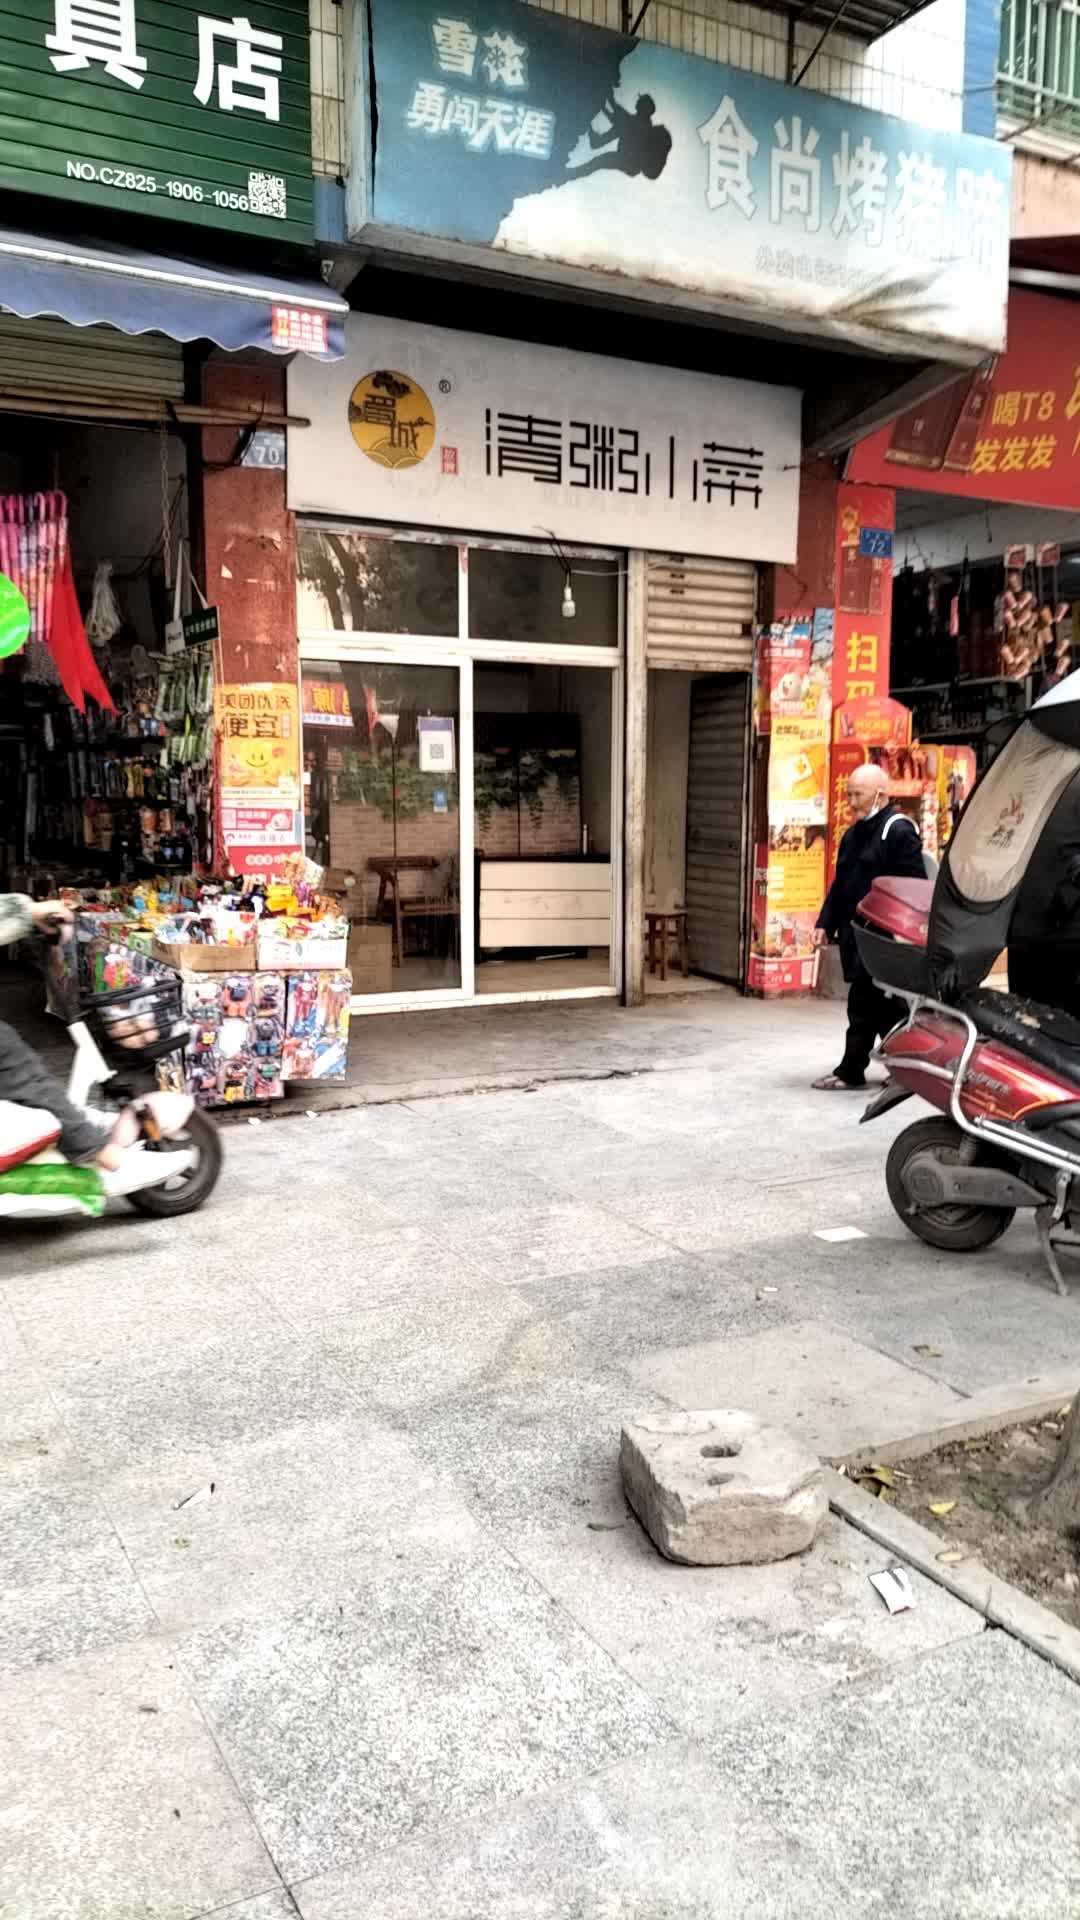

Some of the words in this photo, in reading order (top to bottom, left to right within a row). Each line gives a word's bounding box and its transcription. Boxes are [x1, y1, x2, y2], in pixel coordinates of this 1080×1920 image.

[407, 81, 555, 159] 勇闯天涯
[66, 160, 249, 211] NO.CZ825-1906-1056
[697, 94, 1004, 271] 食尚烤猪蹄
[991, 391, 1056, 426] 喝T8
[255, 446, 280, 464] 70
[970, 432, 1057, 476] 发发发
[218, 693, 291, 711] 美团优选
[221, 712, 280, 738] 便宜
